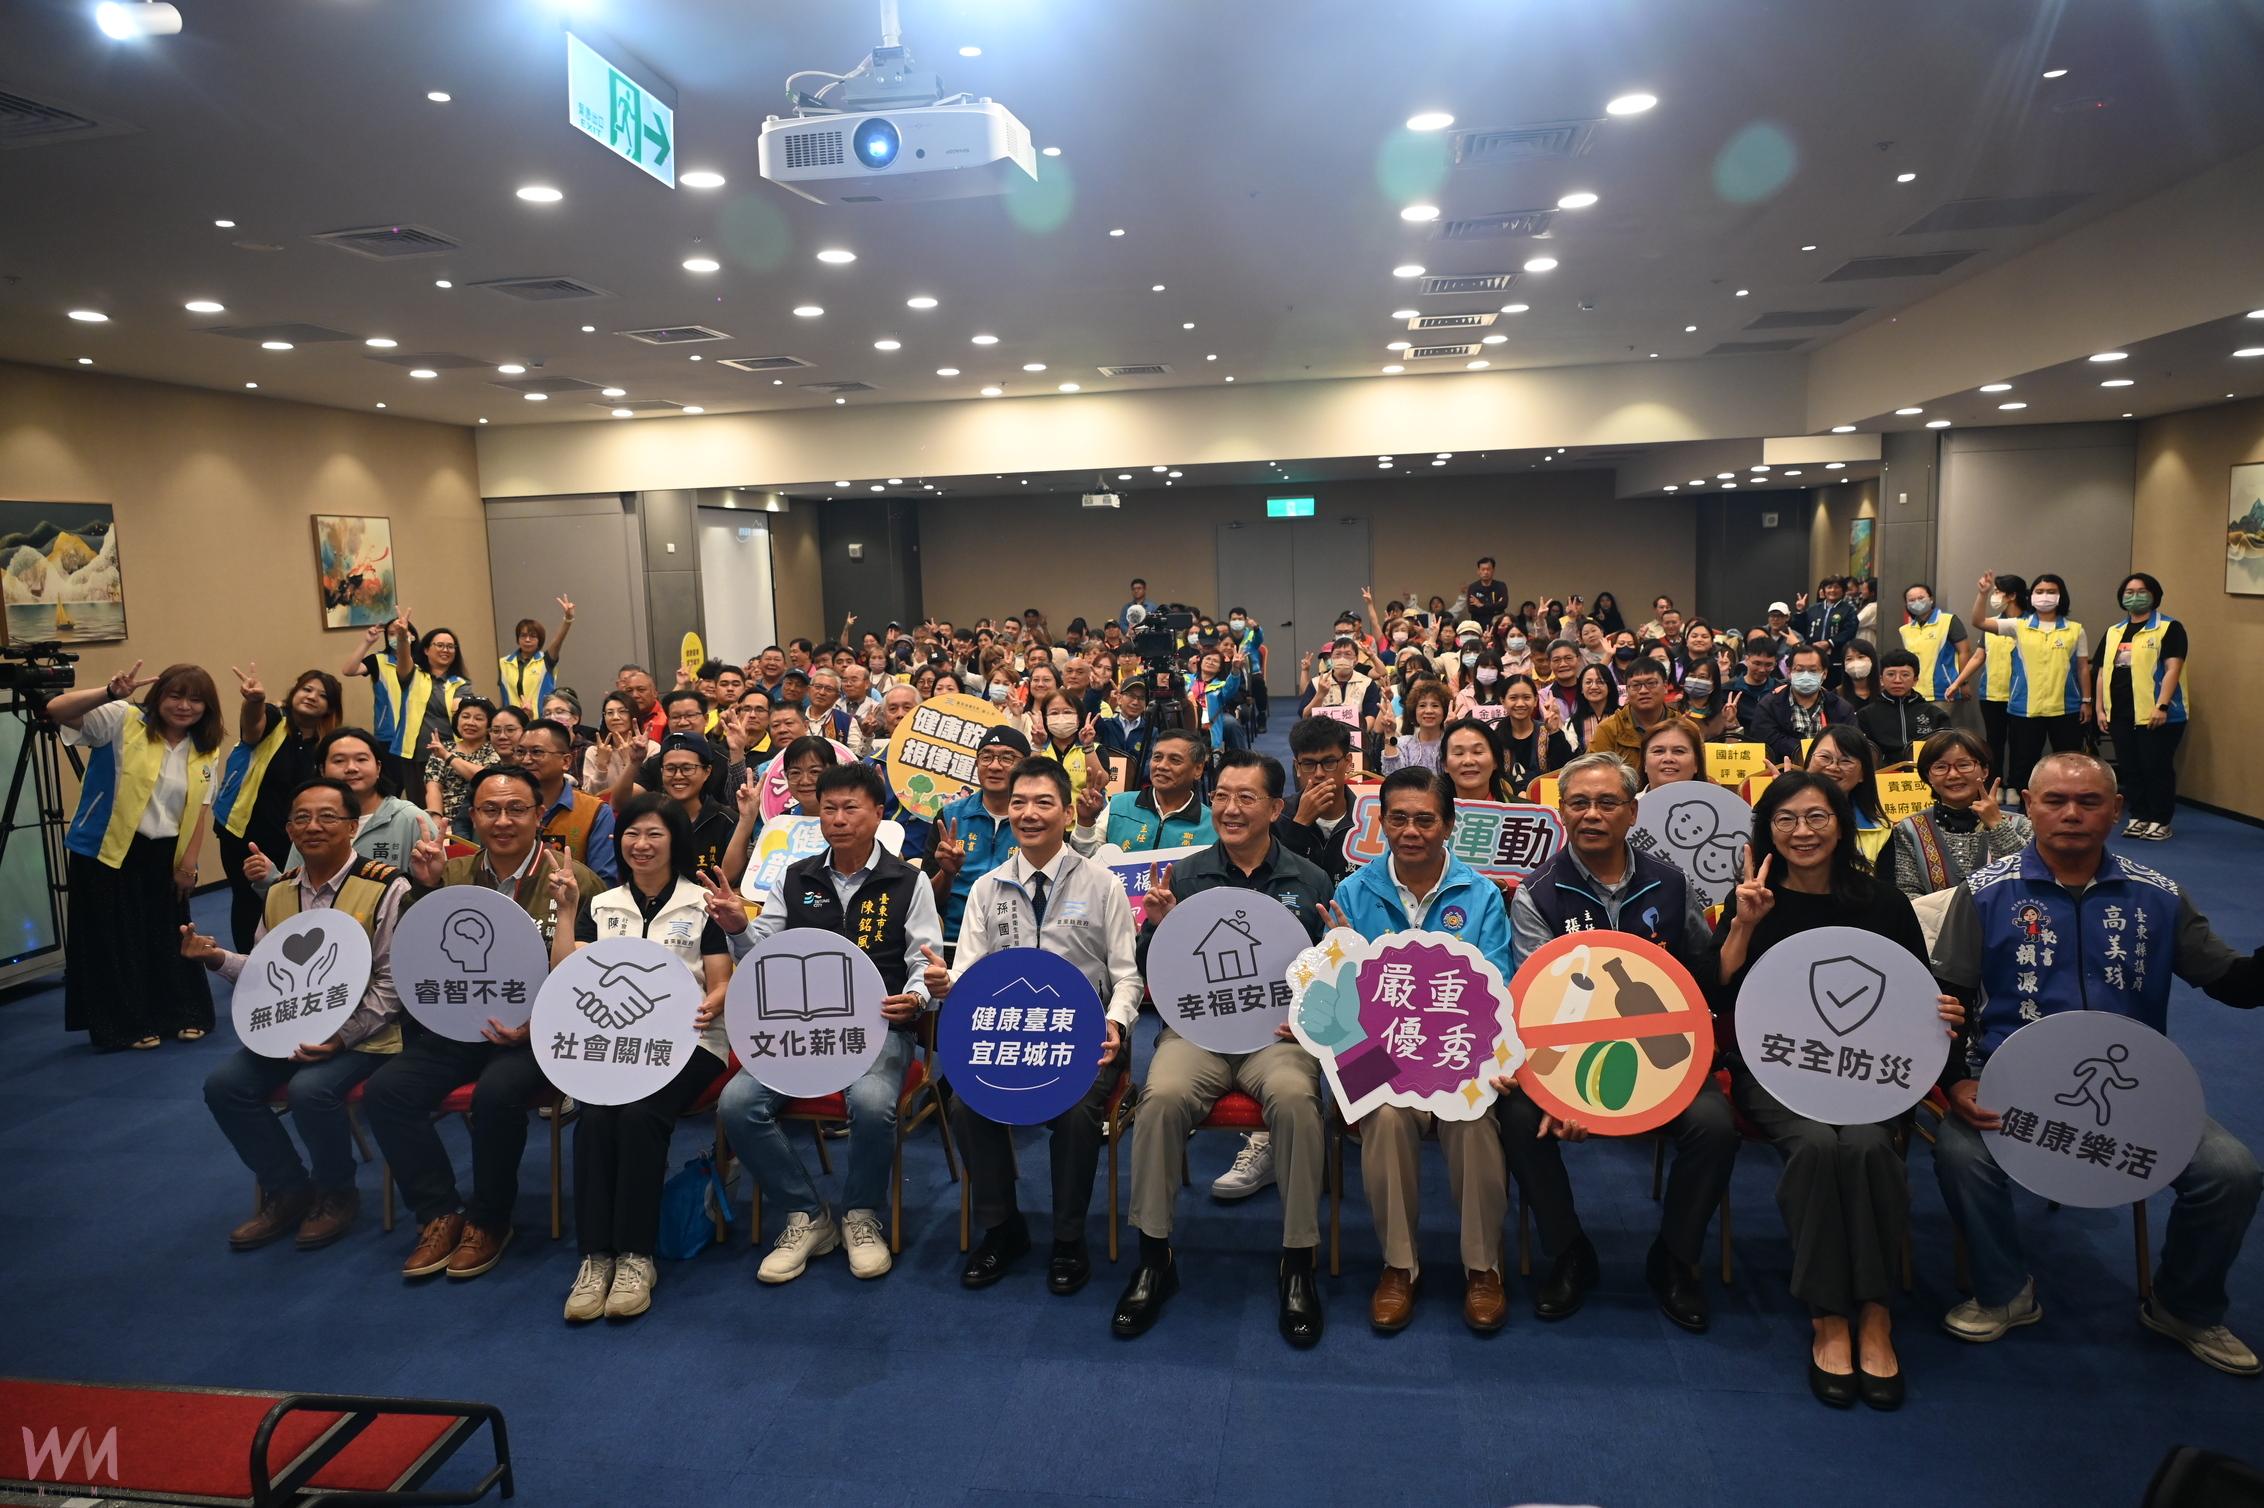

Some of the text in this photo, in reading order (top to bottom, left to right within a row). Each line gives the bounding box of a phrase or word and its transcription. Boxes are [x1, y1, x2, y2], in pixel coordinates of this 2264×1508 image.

[899, 738, 979, 788] 規律運
[1715, 749, 1751, 761] 國計處
[1720, 768, 1747, 779] 評審
[607, 916, 619, 930] 陳
[856, 899, 875, 950] 陳銘風
[873, 892, 890, 943] 臺東市長
[1564, 916, 1581, 934] 張
[2102, 904, 2128, 991] 高美珠
[2131, 907, 2148, 992] 臺東縣議員
[249, 983, 350, 1031] 無礙友善
[414, 979, 527, 1005] 睿智不老
[1176, 979, 1293, 1022] 幸福安居
[1371, 962, 1471, 1018] 嚴重
[970, 1004, 1076, 1034] 健康臺東
[550, 1031, 675, 1068] 社會關懷
[748, 1027, 868, 1060] 文化薪傳
[968, 1038, 1076, 1069] 宜居城市
[1381, 1014, 1479, 1071] 優秀
[1759, 1031, 1914, 1091] 安全防災
[1998, 1104, 2159, 1183] 健康樂活
